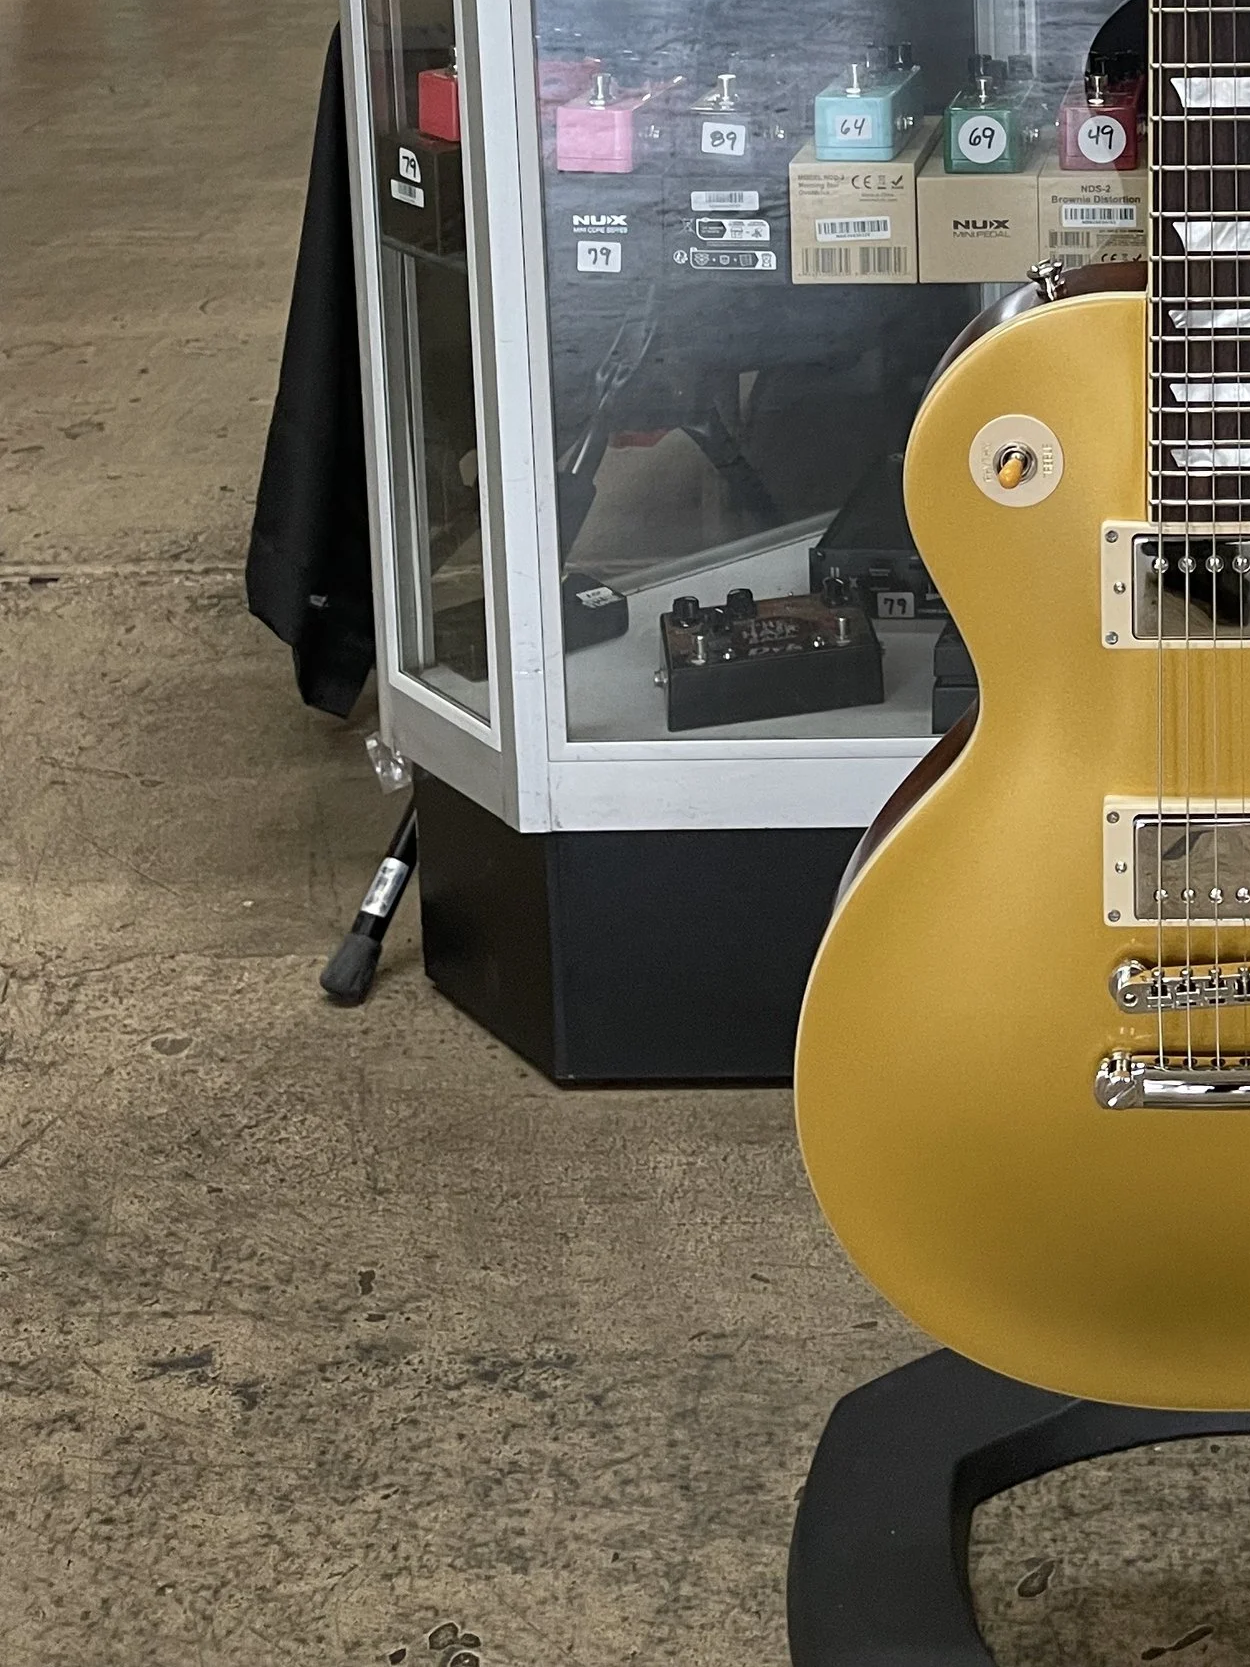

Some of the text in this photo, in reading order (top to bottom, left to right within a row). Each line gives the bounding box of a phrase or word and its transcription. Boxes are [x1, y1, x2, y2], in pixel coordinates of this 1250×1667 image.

[839, 116, 867, 136] 64
[968, 126, 996, 150] 69
[1087, 124, 1115, 150] 49
[402, 156, 416, 178] 79
[1080, 184, 1112, 193] NDS-2
[1051, 195, 1141, 204] Brownie Distortion
[572, 214, 628, 226] NUX
[952, 219, 1010, 230] NUX
[587, 246, 612, 266] 79
[883, 597, 908, 615] 79
